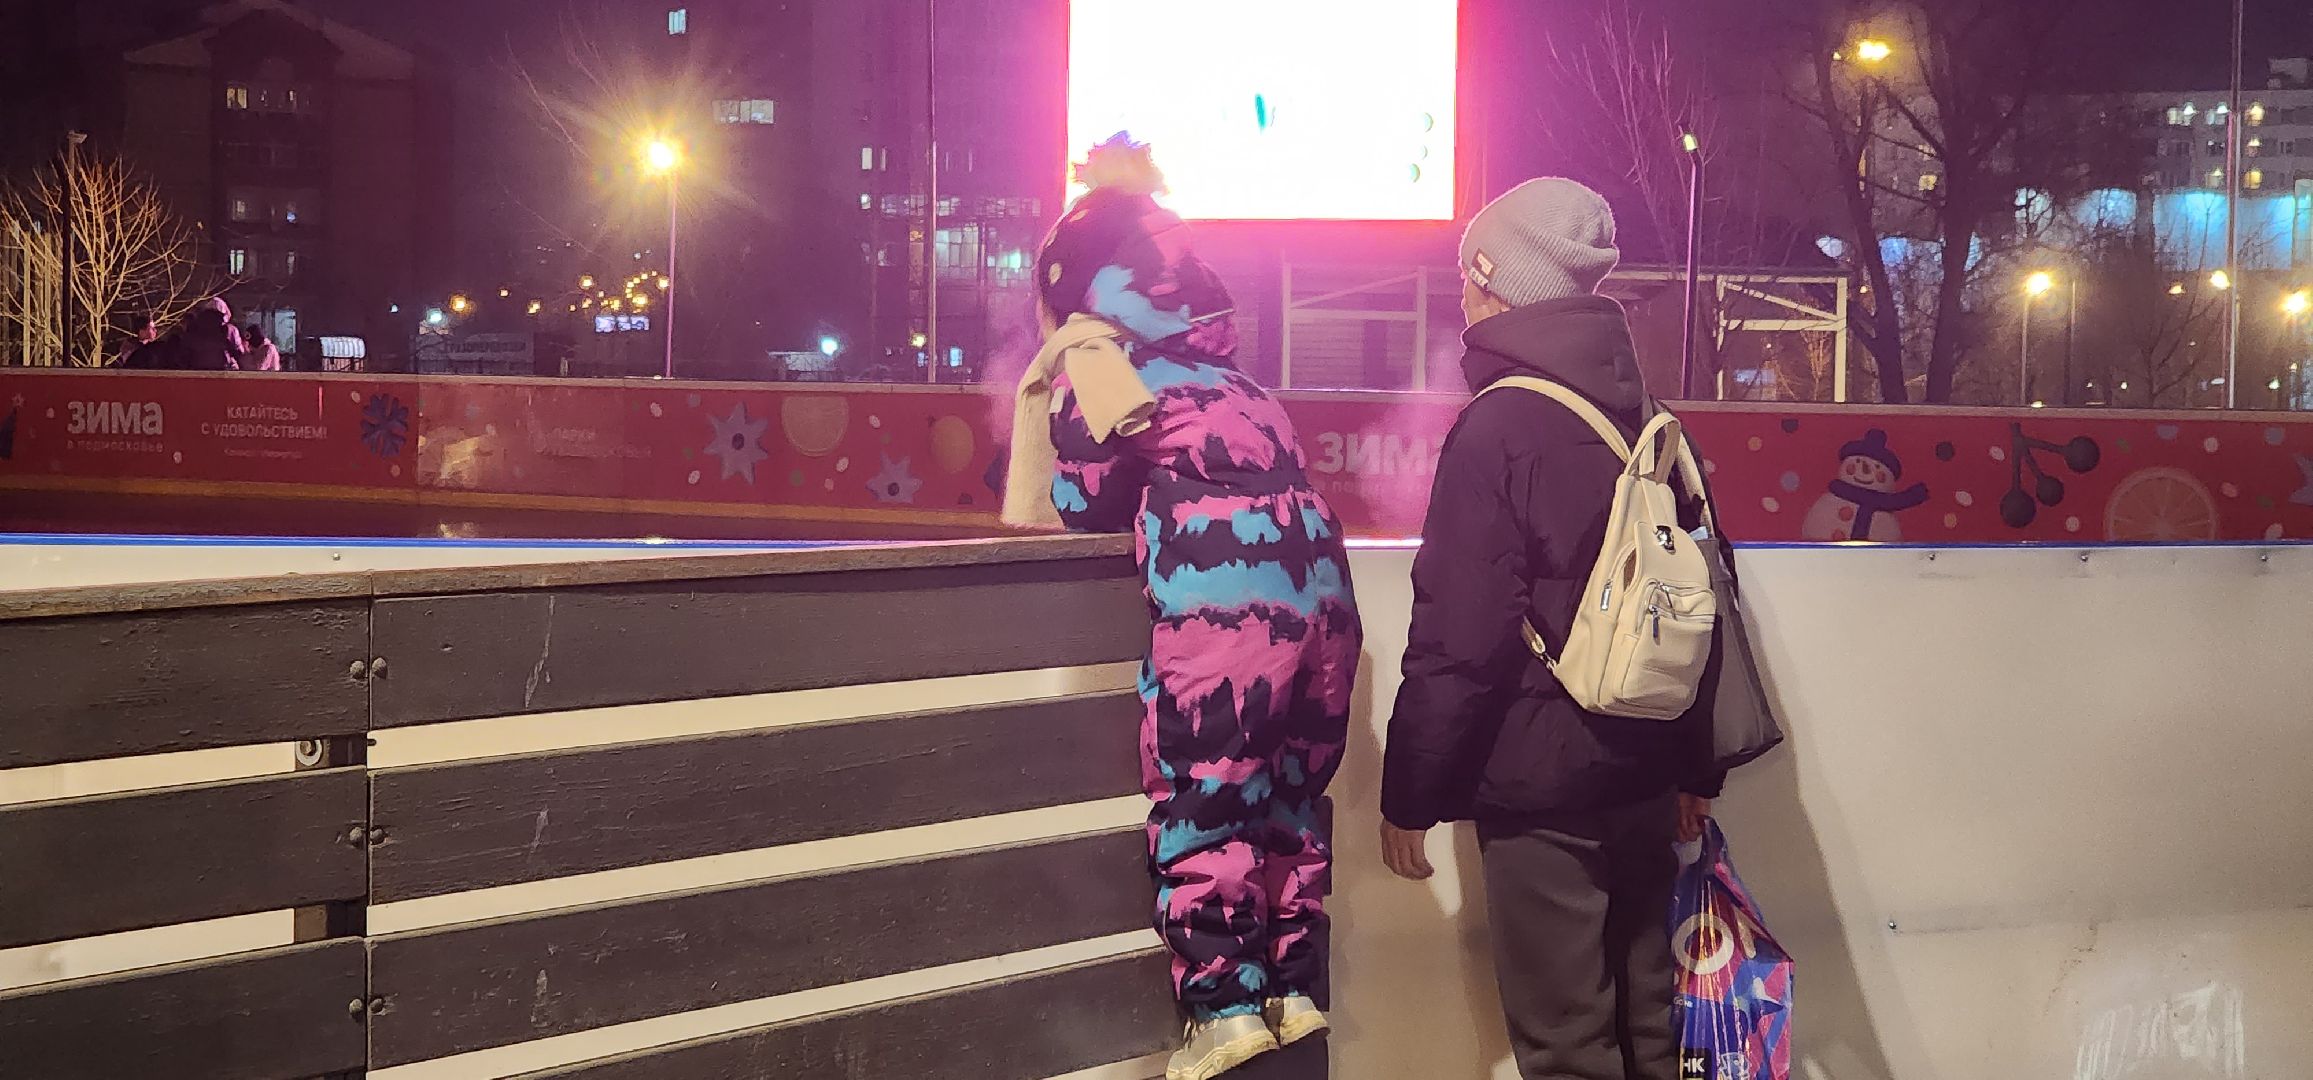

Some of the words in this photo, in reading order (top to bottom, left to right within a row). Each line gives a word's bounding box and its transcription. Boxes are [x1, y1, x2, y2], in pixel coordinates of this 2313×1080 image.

[226, 403, 298, 421] КАТАЙТЕСЬ
[201, 422, 210, 435] С
[214, 423, 328, 440] УДОВОЛЬСТВИЕМ!
